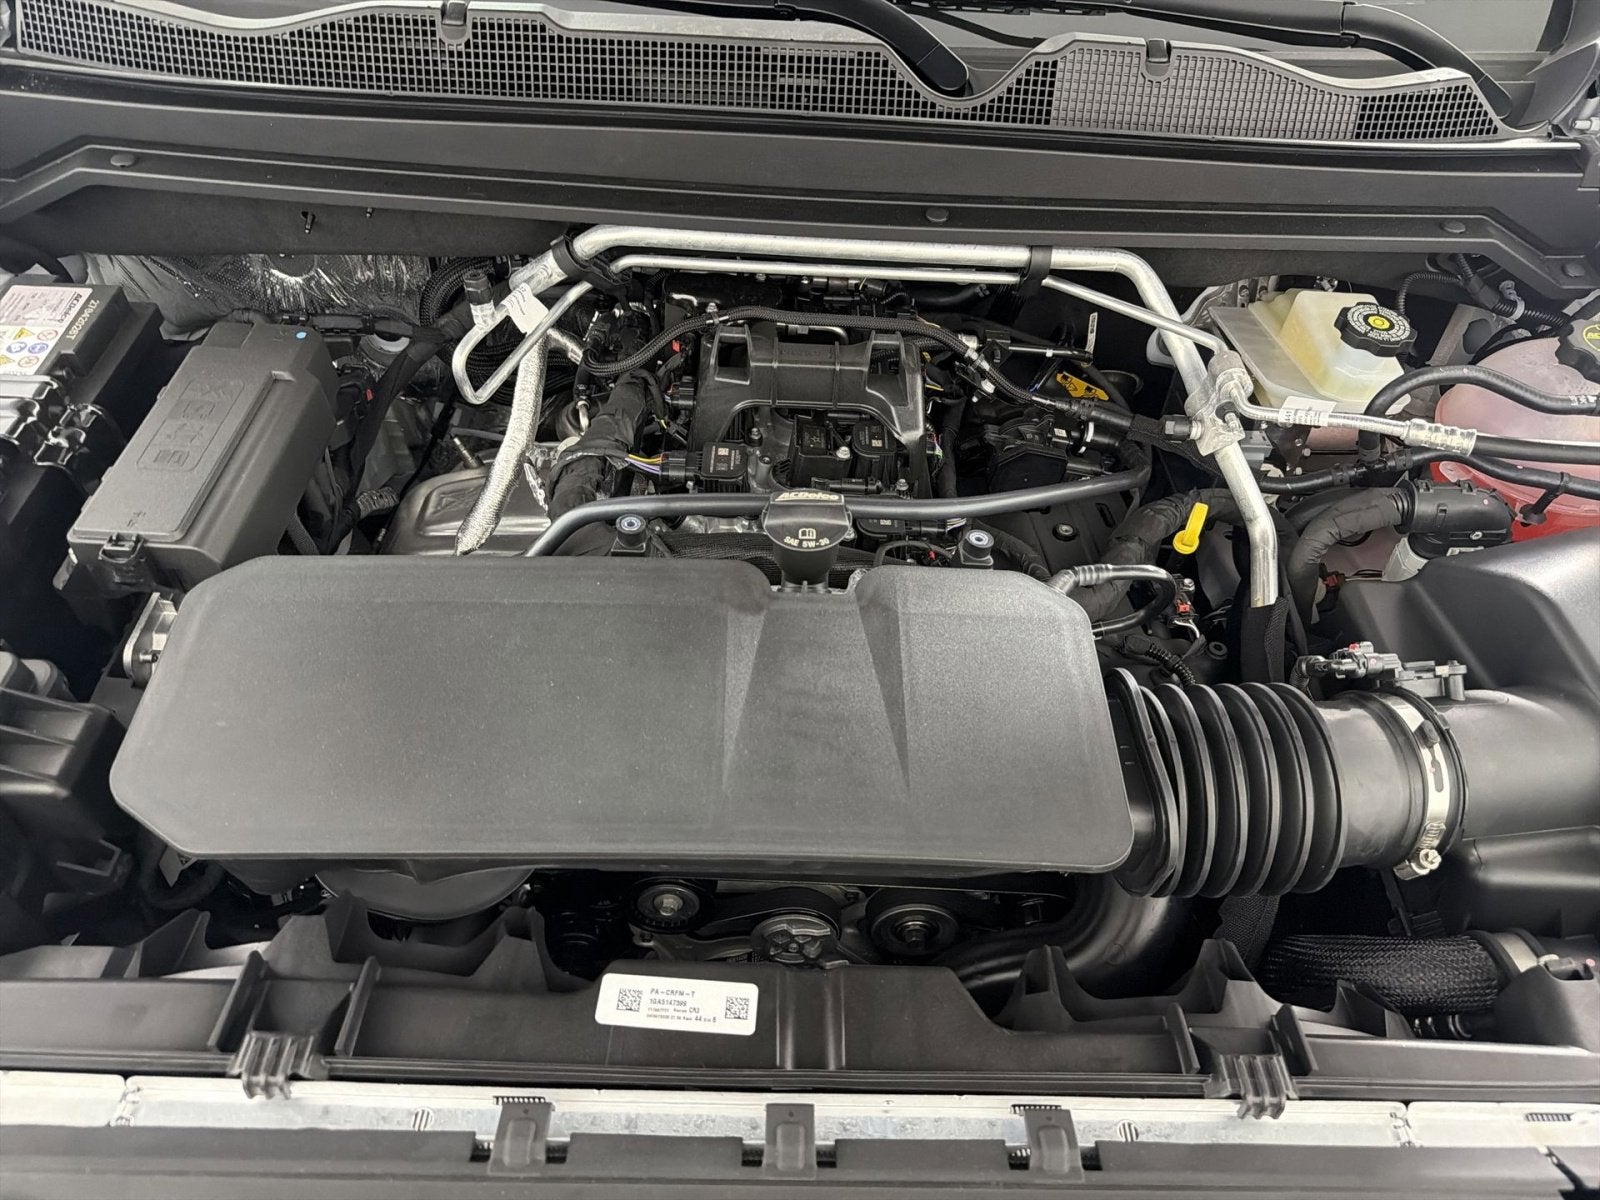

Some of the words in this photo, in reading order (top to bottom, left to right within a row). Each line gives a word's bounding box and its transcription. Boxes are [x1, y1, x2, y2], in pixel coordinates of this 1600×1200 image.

[775, 492, 839, 501] ACDelco
[783, 536, 800, 547] SAE
[802, 538, 830, 548] 5W-30
